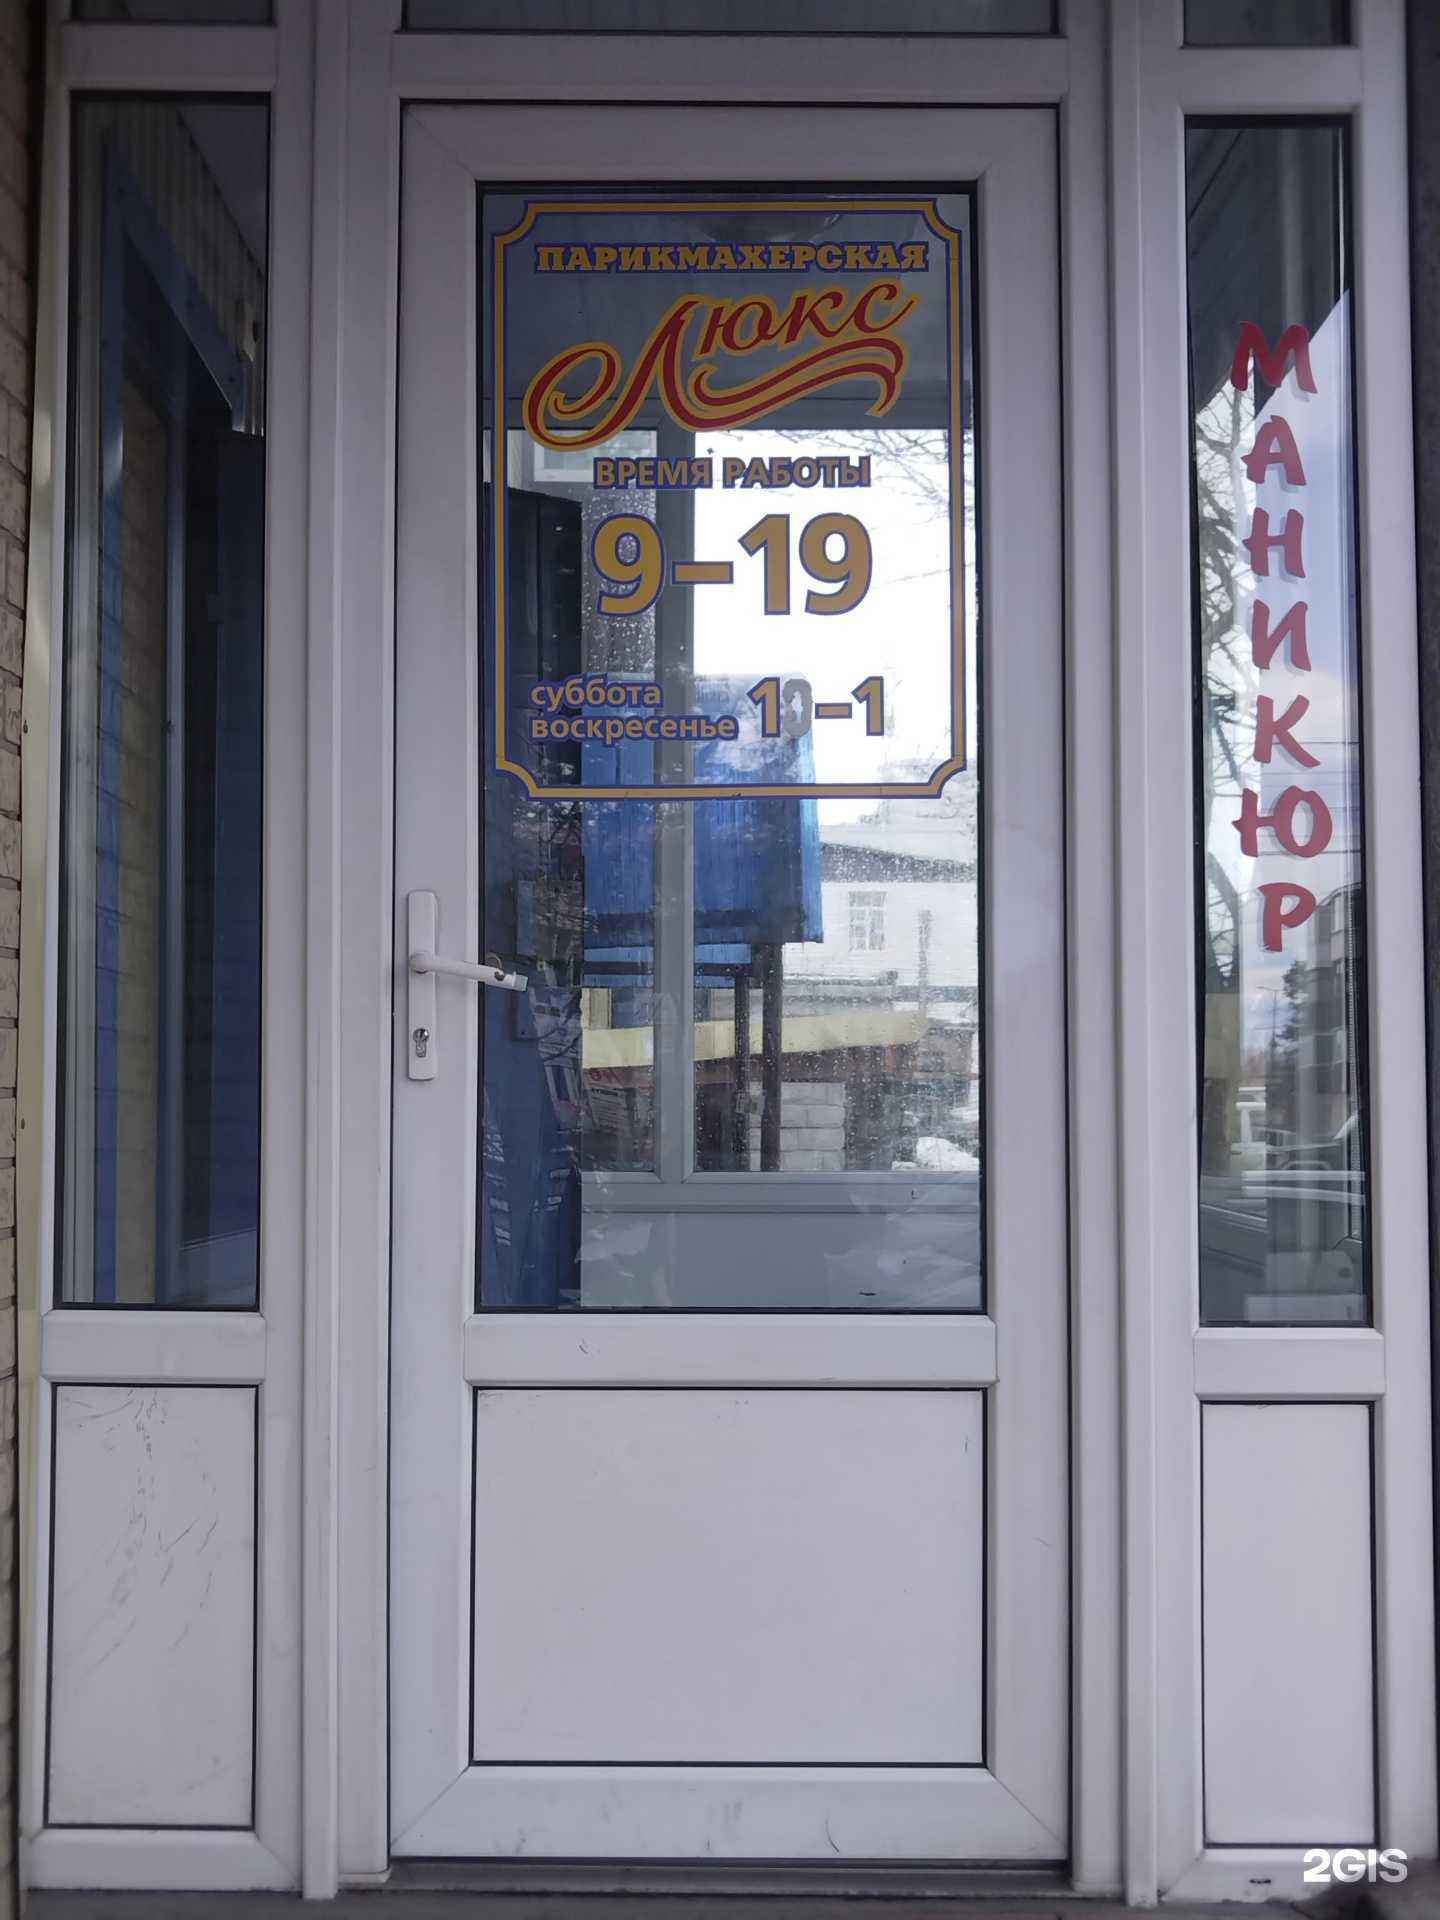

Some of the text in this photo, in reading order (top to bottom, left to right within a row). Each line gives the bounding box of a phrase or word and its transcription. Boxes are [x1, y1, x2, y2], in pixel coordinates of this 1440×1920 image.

[535, 242, 929, 272] ПАРИКМАХЕРСКАЯ
[522, 279, 918, 452] Люкс
[593, 456, 872, 489] ВРЕМЯ РАБОТЫ
[1231, 321, 1332, 951] МАНИКЮР
[529, 673, 663, 711] суббота
[529, 714, 740, 745] воскресенье
